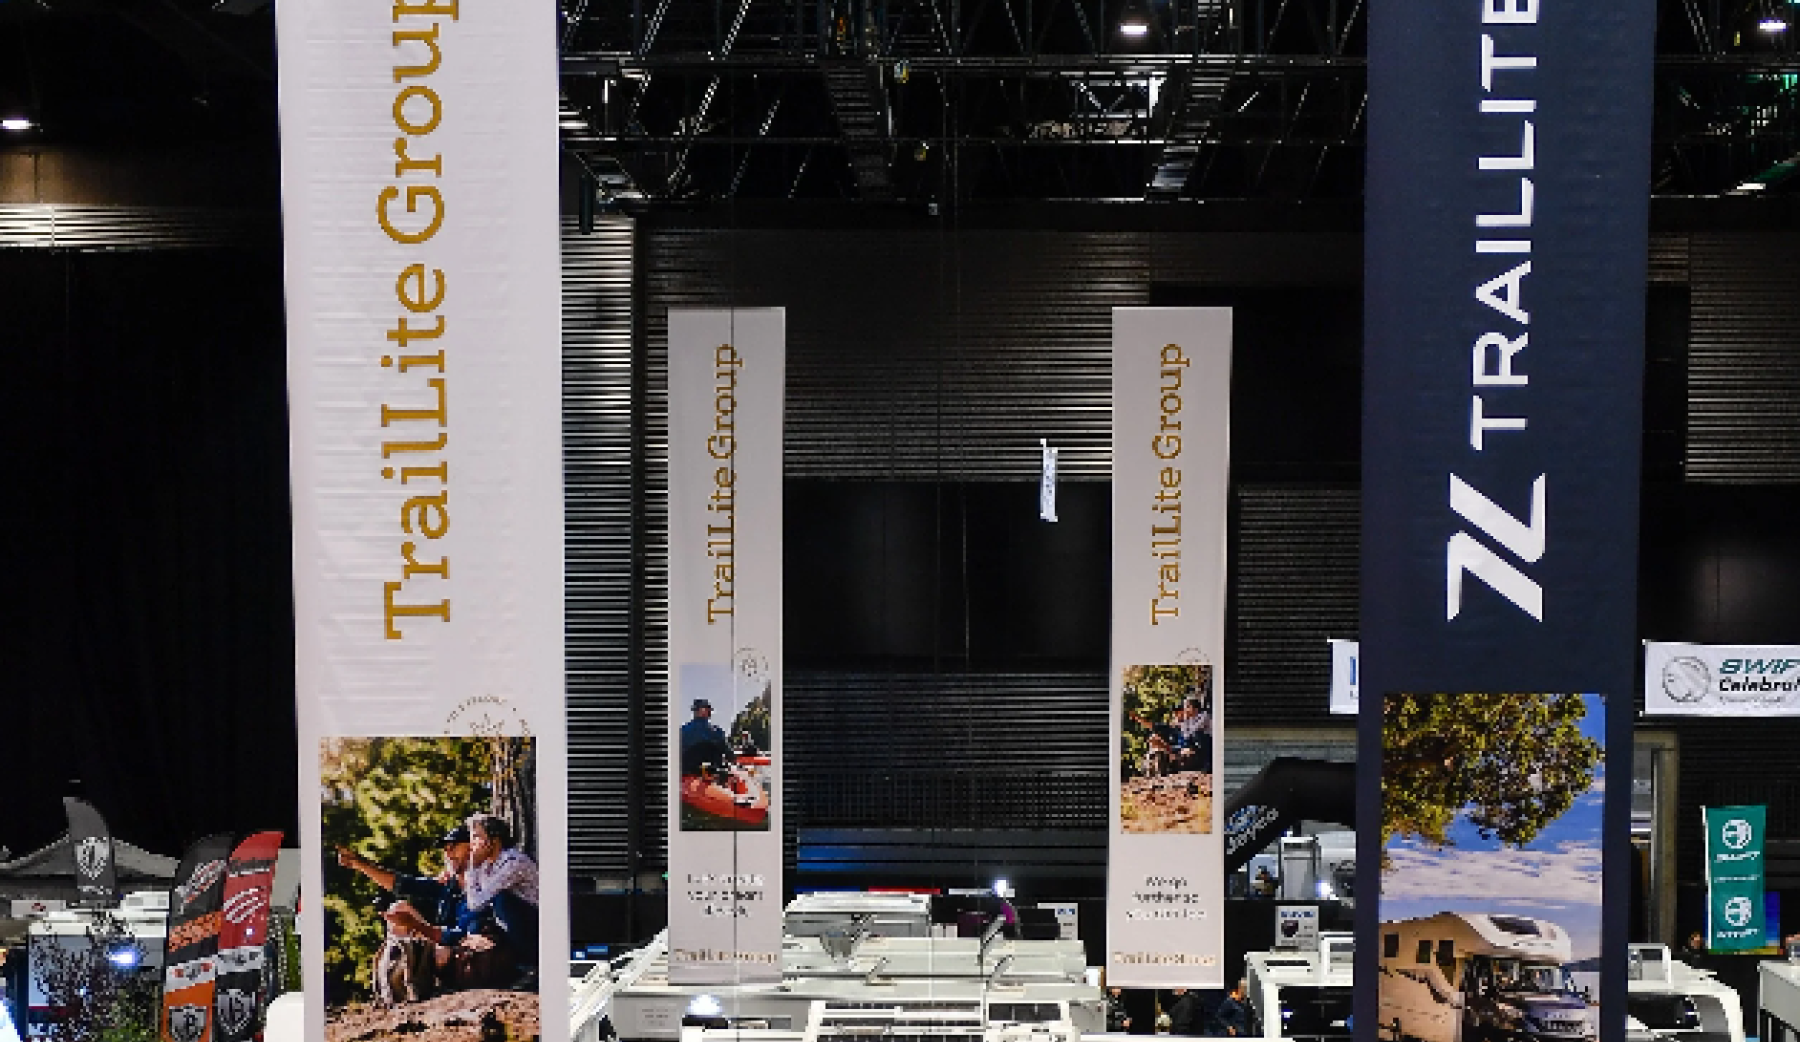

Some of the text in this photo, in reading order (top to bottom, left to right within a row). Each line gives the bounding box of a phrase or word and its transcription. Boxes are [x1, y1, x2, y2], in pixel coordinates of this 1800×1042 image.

[380, 263, 450, 639] TrailLite
[707, 343, 743, 625] TrailLite Group
[1151, 343, 1190, 625] TrailLite Group
